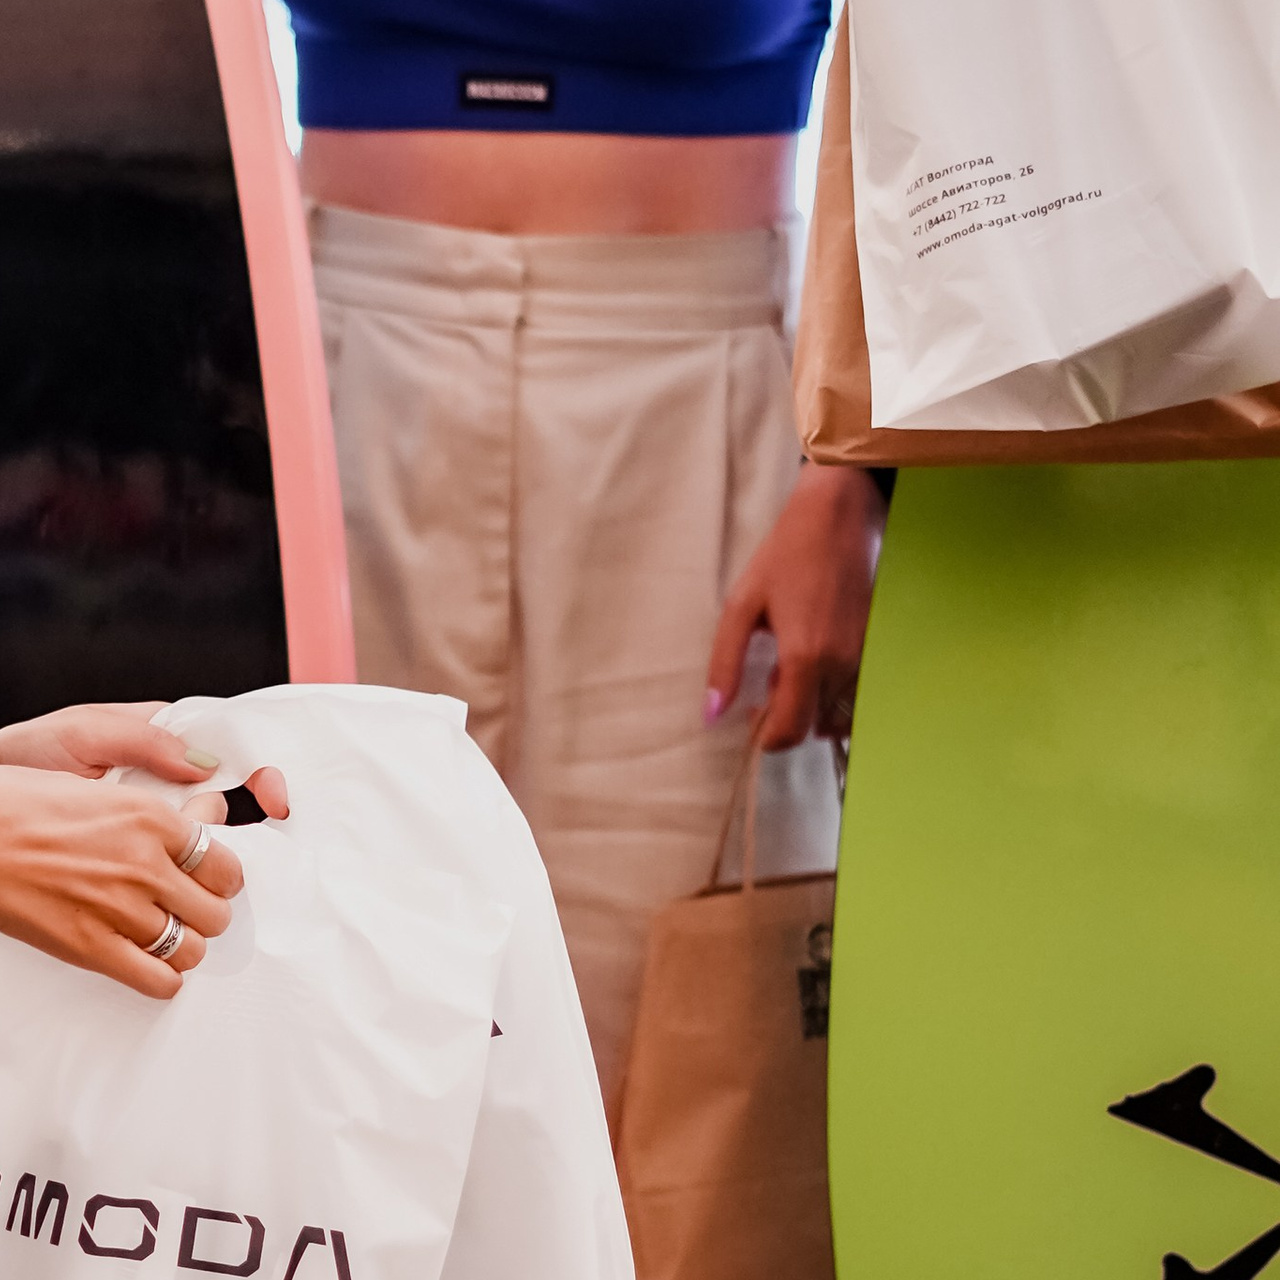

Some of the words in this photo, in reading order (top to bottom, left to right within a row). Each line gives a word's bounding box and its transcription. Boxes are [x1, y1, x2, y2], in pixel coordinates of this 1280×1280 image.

[926, 155, 994, 183] Волгоград
[908, 195, 938, 219] шоссе
[941, 172, 1016, 200] Авиаторов,
[912, 224, 923, 237] +7
[924, 208, 957, 233] (8442)
[959, 193, 1007, 215] 722-722
[916, 188, 1103, 260] www.omoda-agat-volgograd.ru
